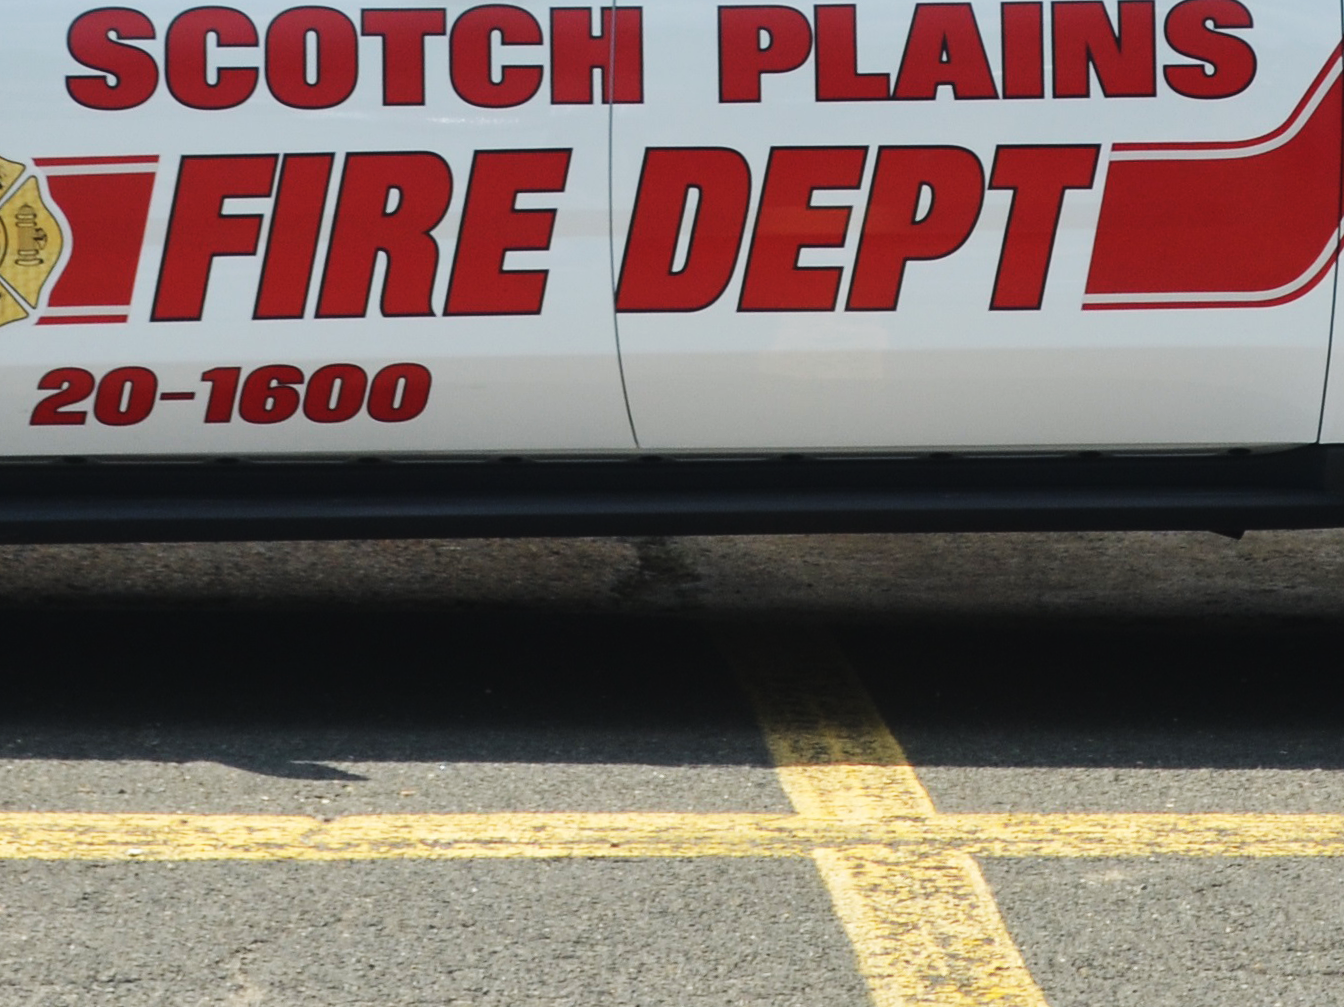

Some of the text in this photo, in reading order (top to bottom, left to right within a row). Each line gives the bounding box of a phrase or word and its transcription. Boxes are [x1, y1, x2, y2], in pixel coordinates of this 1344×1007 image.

[64, 4, 645, 111] SCOTCH
[149, 142, 1101, 324] FIRE DEPT
[29, 361, 433, 428] 20-1600
